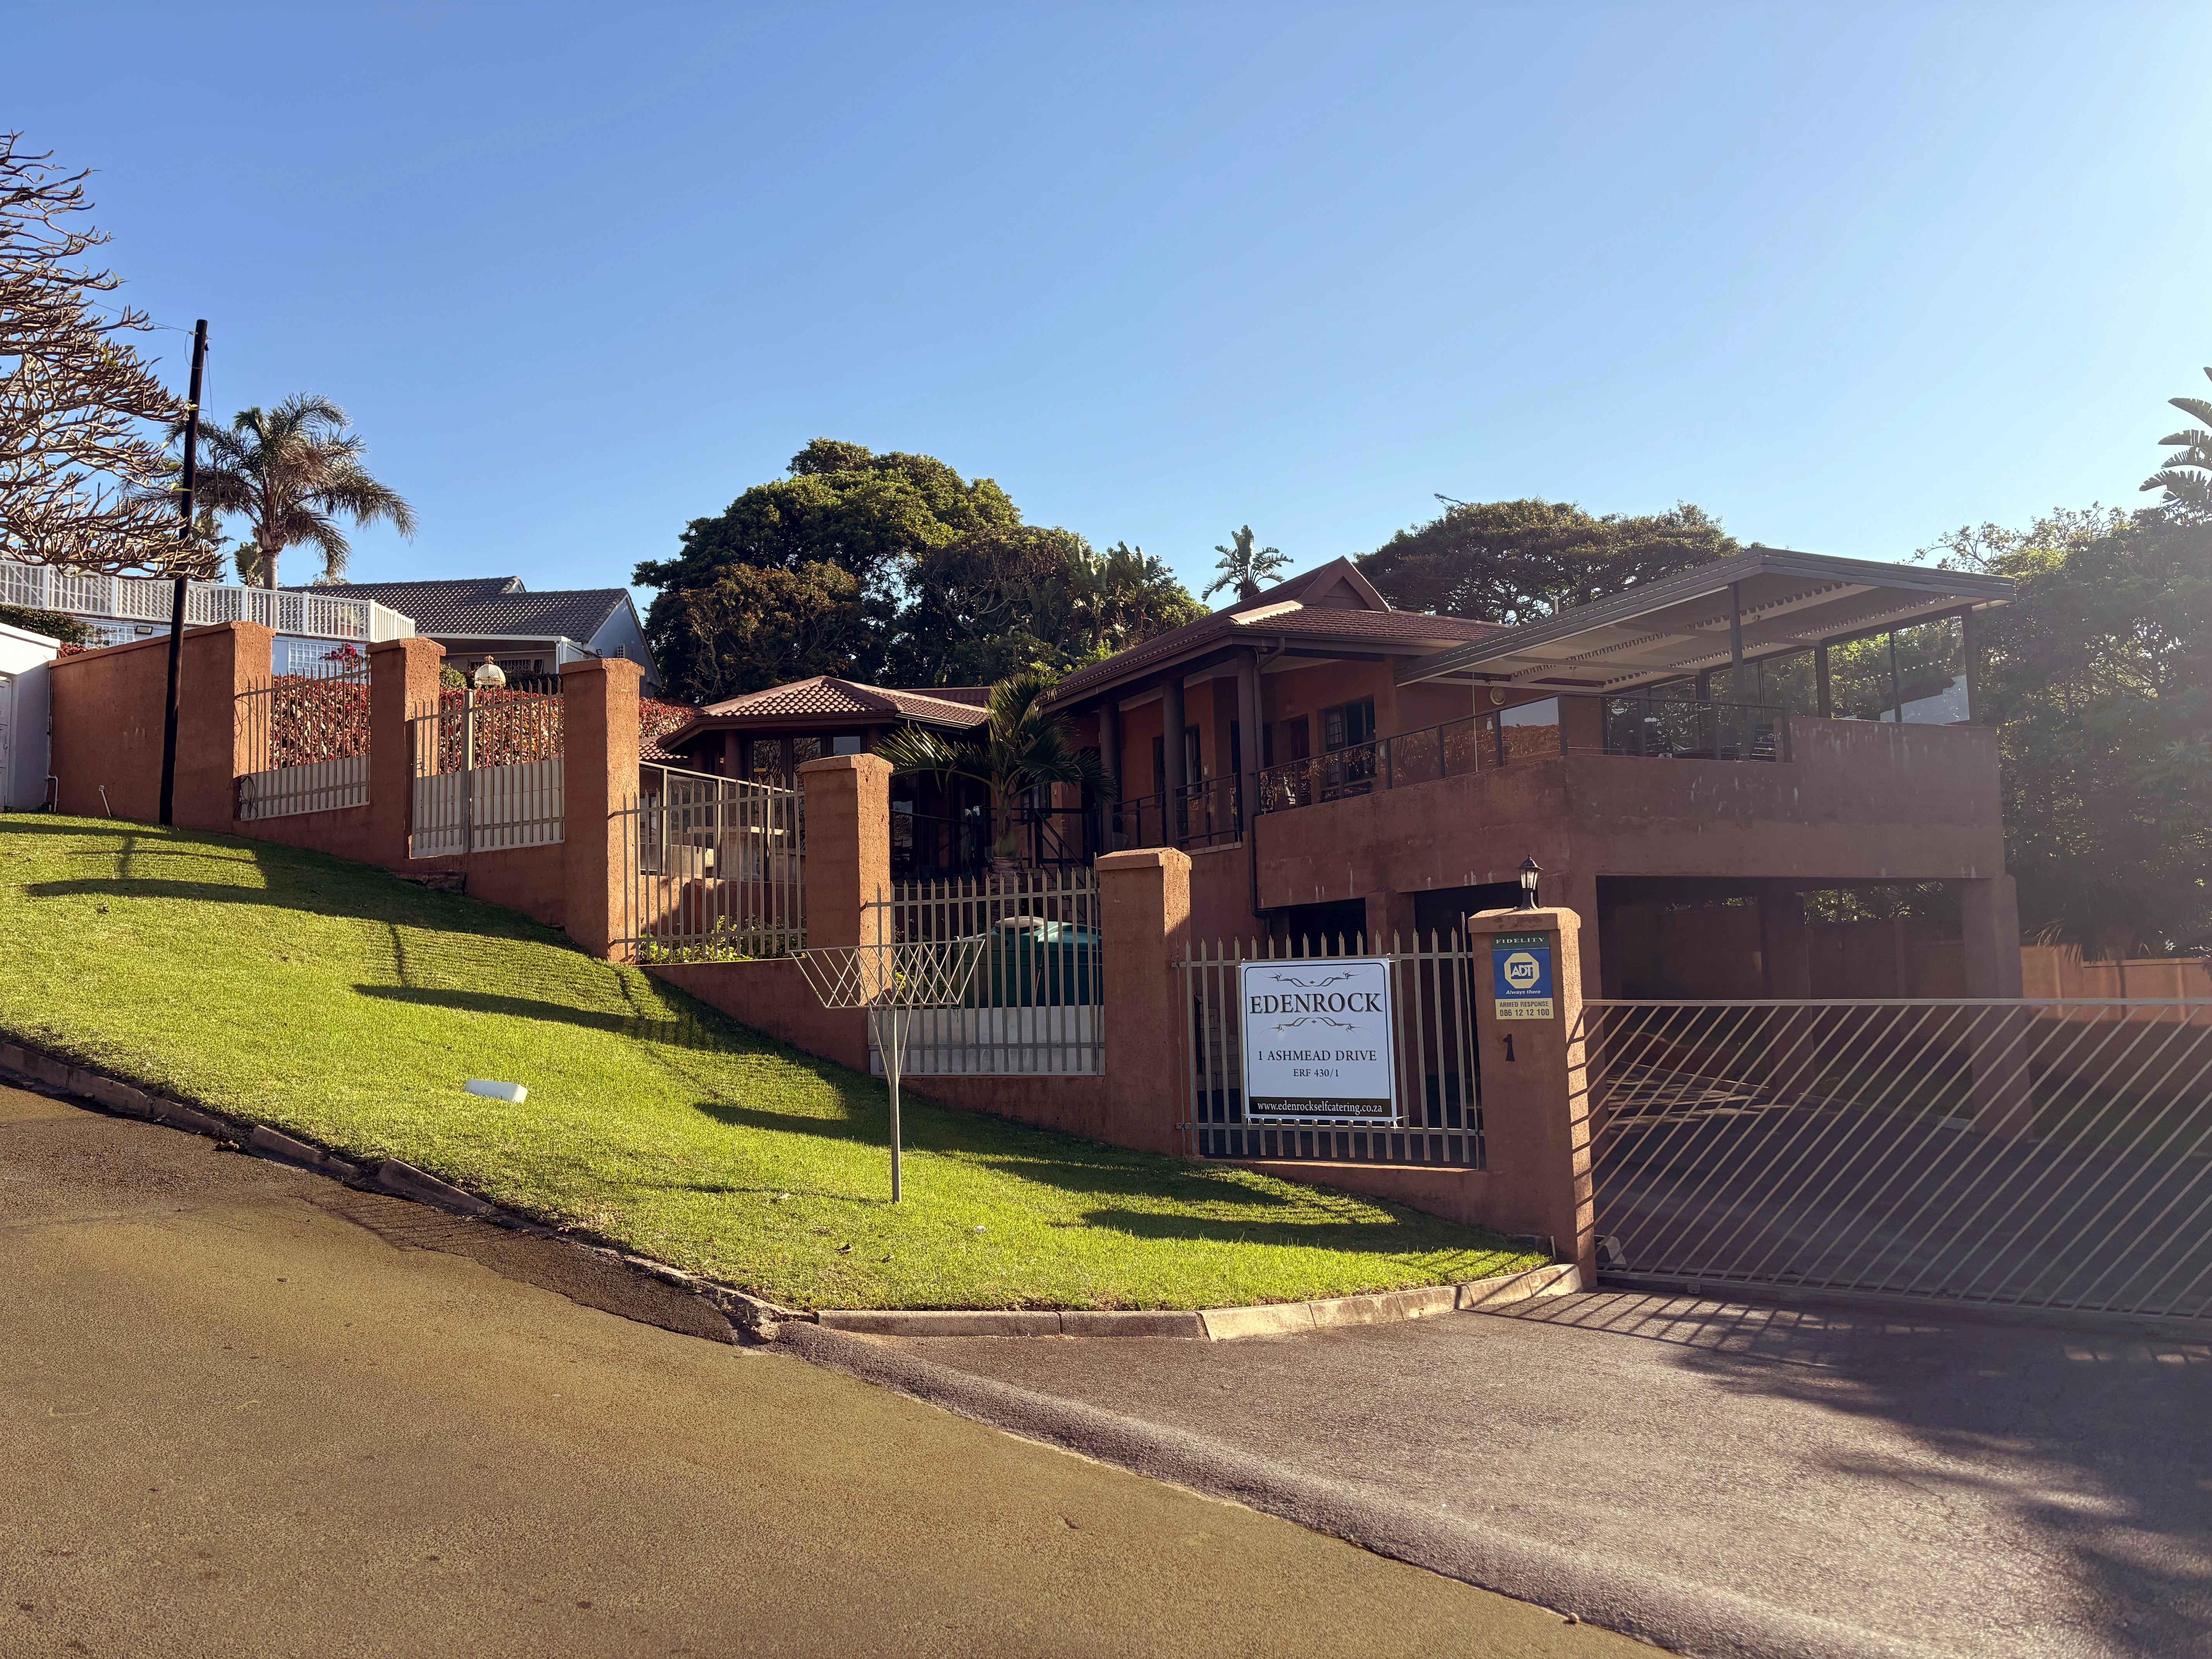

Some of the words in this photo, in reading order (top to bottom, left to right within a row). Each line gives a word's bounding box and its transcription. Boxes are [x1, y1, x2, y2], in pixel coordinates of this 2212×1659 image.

[1511, 965, 1533, 977] ADT
[1250, 993, 1383, 1014] EDENROCK
[1503, 1034, 1515, 1061] 1
[1258, 1051, 1262, 1060] 1
[1267, 1050, 1331, 1061] ASHMEAD
[1335, 1050, 1377, 1061] DRIVE
[1314, 1068, 1339, 1078] 430/1
[1258, 1100, 1382, 1115] www.edenrockselfcatering.co.za
